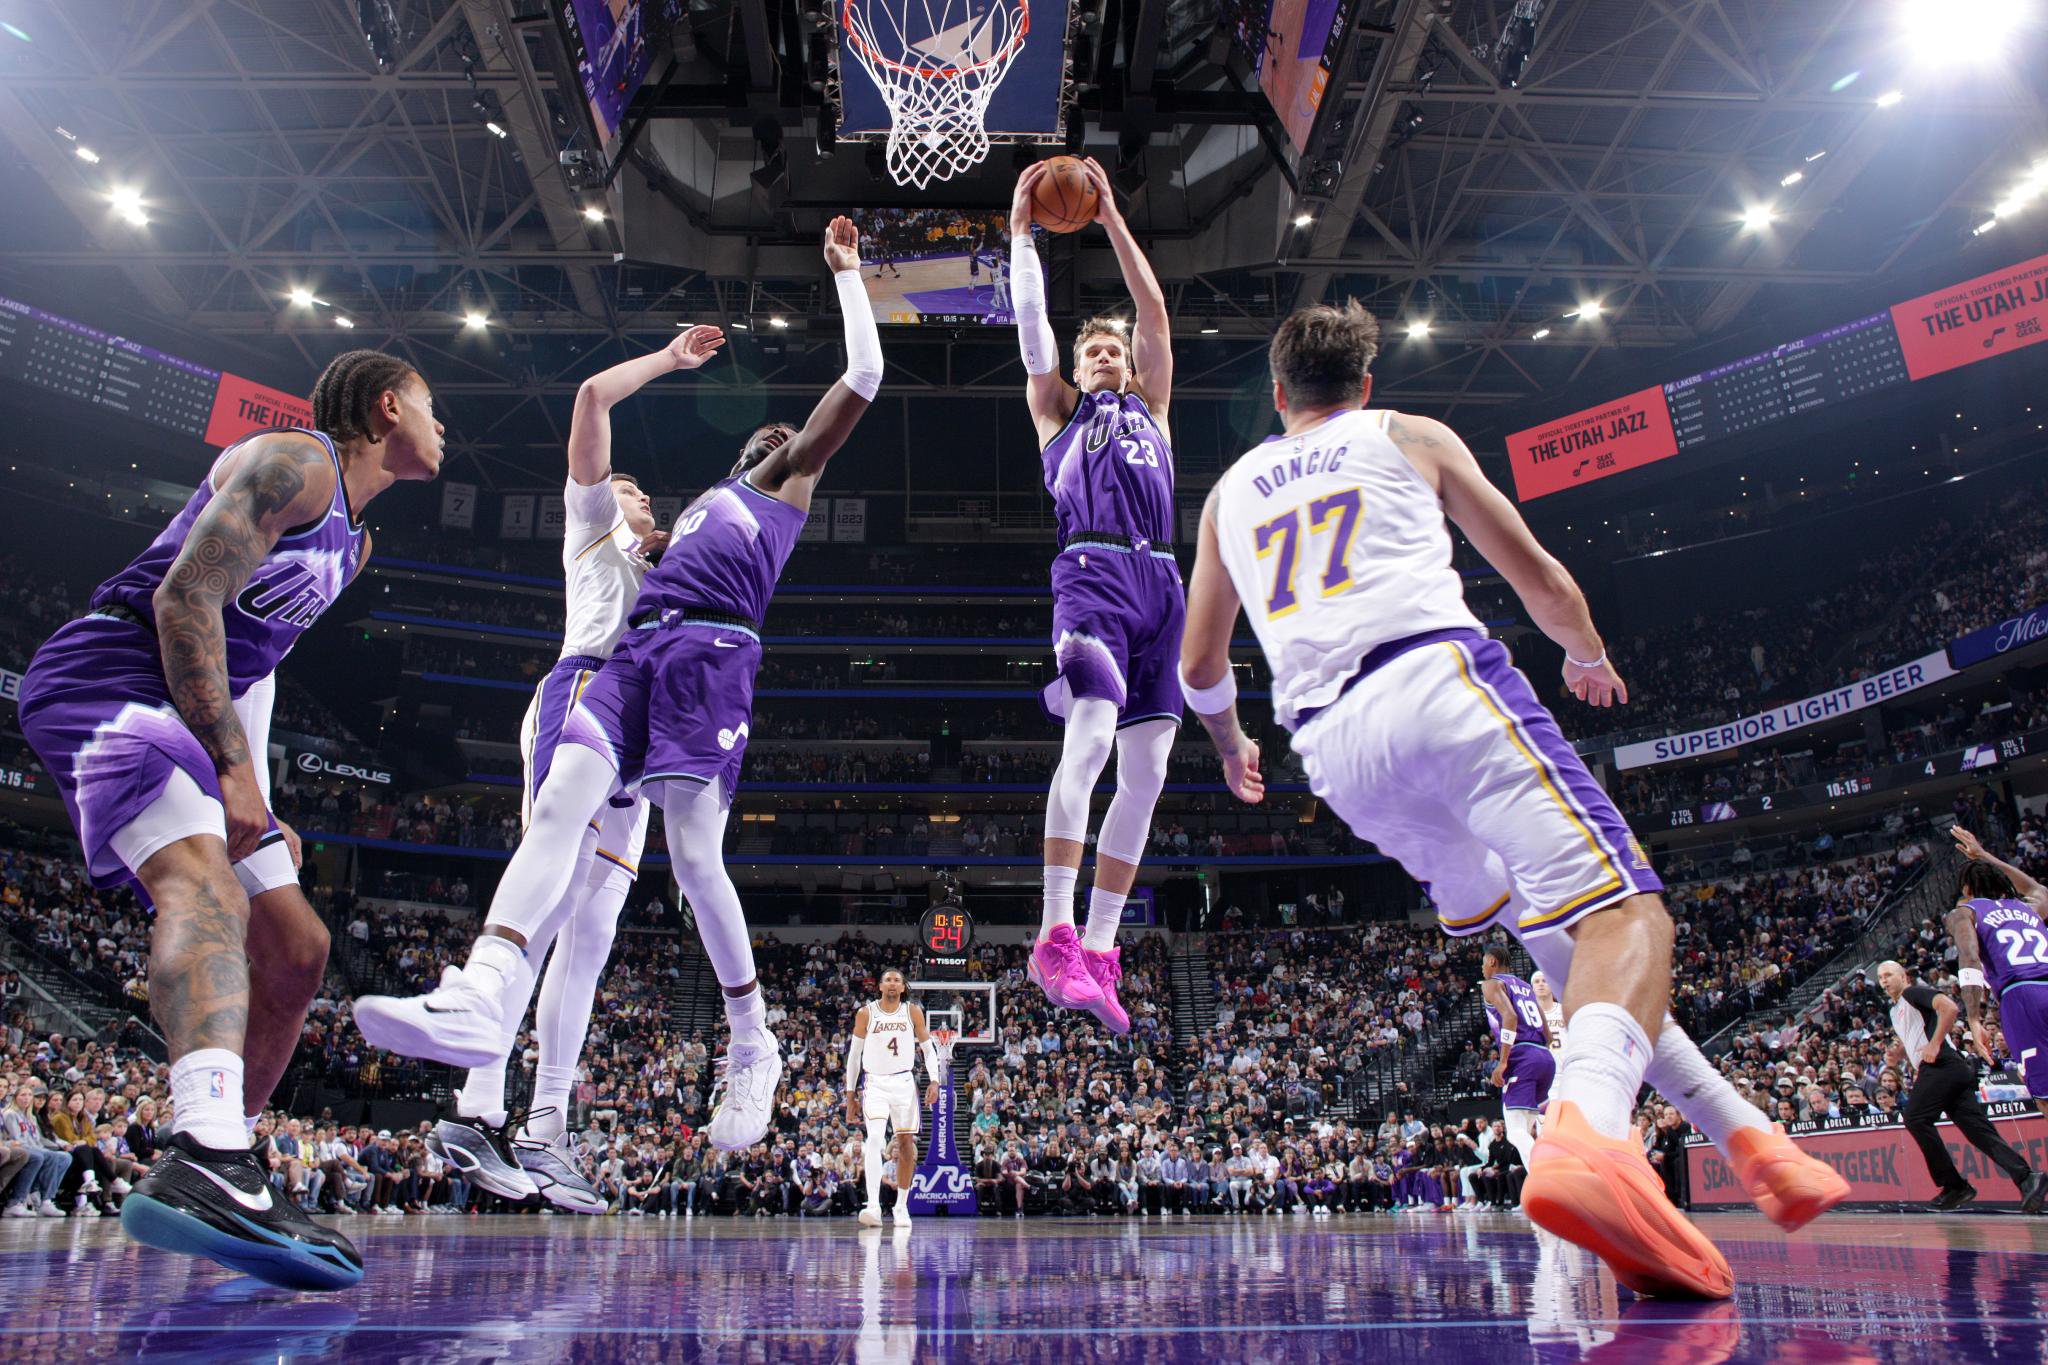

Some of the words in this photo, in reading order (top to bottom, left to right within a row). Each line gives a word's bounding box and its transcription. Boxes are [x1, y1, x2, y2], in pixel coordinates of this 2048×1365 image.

[1934, 292, 1969, 308] OFFICIAL
[1971, 278, 2012, 296] TICKETING
[1922, 306, 1965, 336] THE
[1965, 286, 2026, 322] UTAH
[996, 315, 1008, 323] UTA
[2015, 317, 2038, 330] SEAT
[1786, 340, 1804, 352] JAZZ
[1676, 374, 1702, 389] LAKERS
[238, 398, 270, 425] THE
[1538, 428, 1564, 440] OFFICIAL
[1564, 416, 1595, 432] TICKETING
[1596, 408, 1622, 422] PARTNER
[1623, 405, 1631, 413] OF
[1528, 440, 1560, 464] THE
[1561, 426, 1608, 454] UTAH
[1608, 411, 1648, 440] JAZZ
[1120, 440, 1158, 468] 23
[1596, 452, 1614, 463] SEAT
[1597, 460, 1616, 470] GEEK
[454, 498, 464, 512] 7
[660, 512, 669, 525] 9
[1253, 486, 1366, 622] 77
[1654, 715, 1776, 759] SUPERIOR
[1784, 689, 1852, 727] LIGHT
[1862, 664, 1925, 702] BEER
[2003, 748, 2019, 758] FLS
[324, 761, 392, 784] LEXUS
[1924, 761, 1936, 776] 4
[1826, 780, 1859, 798] 10:15
[1762, 796, 1772, 810] 2
[1671, 818, 1677, 826] 0
[1679, 816, 1693, 825] FLS
[935, 914, 964, 927] 10:15
[1983, 909, 2039, 928] PETERSON
[931, 927, 962, 950] 24
[1996, 928, 2048, 966] 22
[1517, 999, 1543, 1028] 19
[872, 1021, 907, 1033] LAKERS
[887, 1037, 898, 1056] 4
[1989, 1073, 2008, 1081] DELTA
[939, 1088, 947, 1114] FIRST
[1995, 1102, 2026, 1113] DELTA
[1797, 1121, 1816, 1131] DELTA
[1830, 1118, 1852, 1128] DELTA
[1866, 1114, 1889, 1125] DELTA
[938, 1116, 947, 1159] AMERICA
[1689, 1134, 1704, 1143] DELTA
